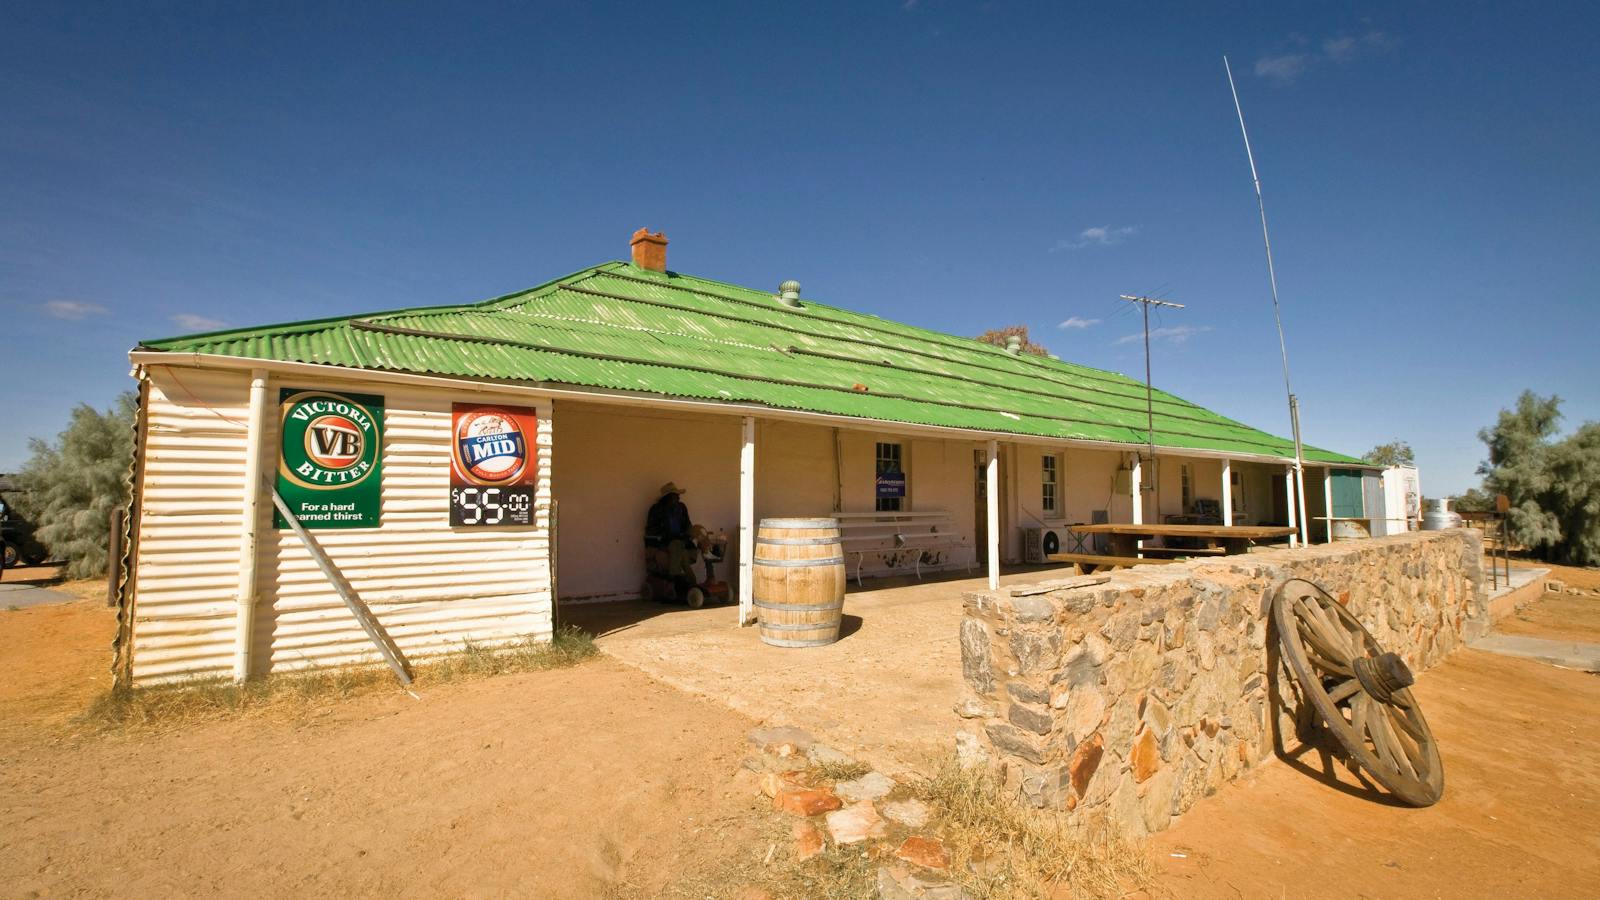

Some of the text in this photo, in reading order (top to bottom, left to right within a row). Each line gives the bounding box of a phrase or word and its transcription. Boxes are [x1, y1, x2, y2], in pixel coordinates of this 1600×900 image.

[291, 401, 371, 432] VICTORIA
[311, 426, 360, 456] VB
[476, 434, 508, 444] CARLTON
[472, 440, 516, 461] MID
[296, 461, 370, 482] BITTER
[301, 502, 320, 511] For
[330, 502, 355, 511] hard
[333, 511, 363, 520] thirst
